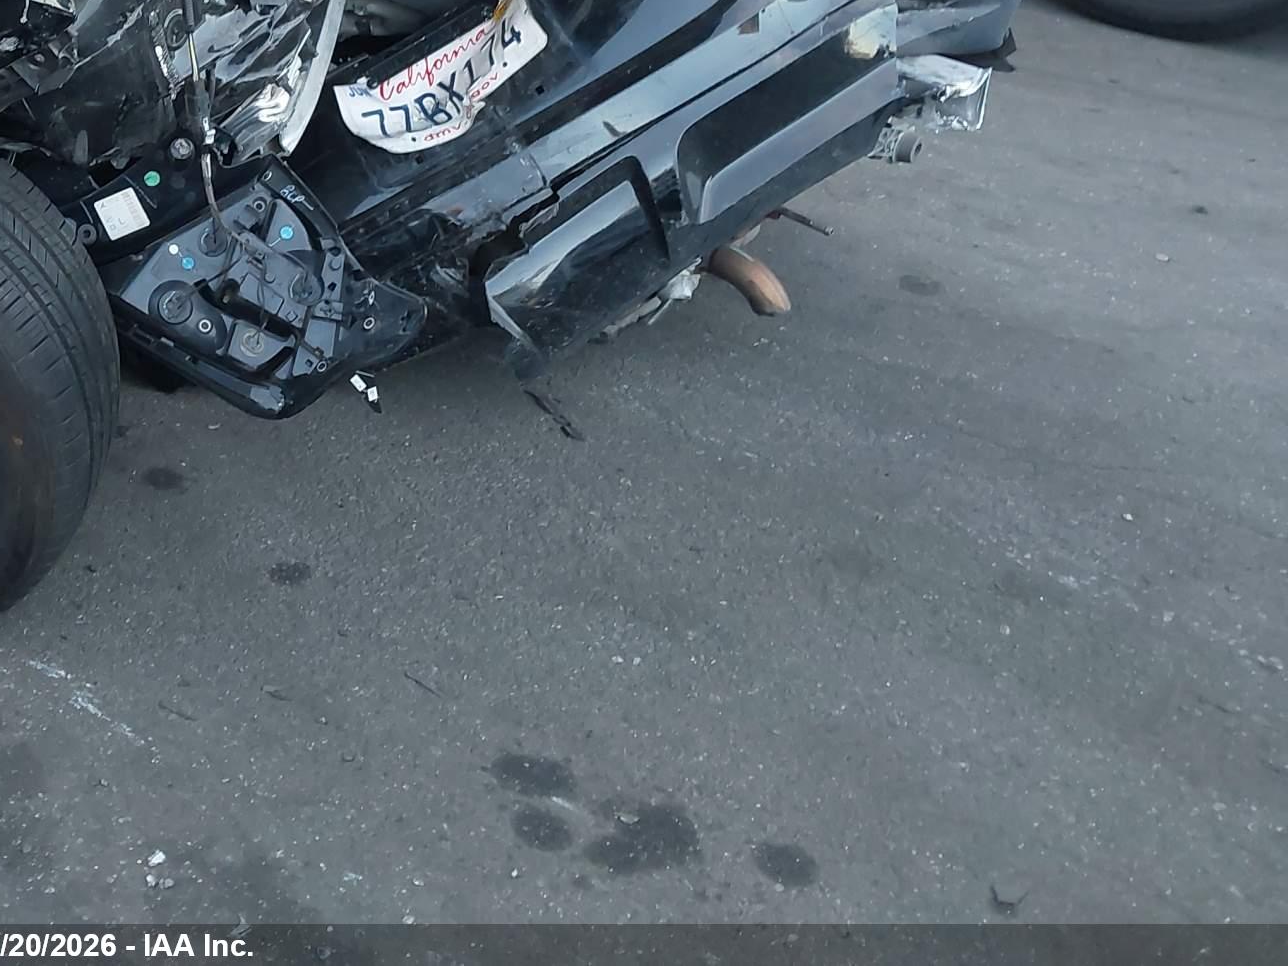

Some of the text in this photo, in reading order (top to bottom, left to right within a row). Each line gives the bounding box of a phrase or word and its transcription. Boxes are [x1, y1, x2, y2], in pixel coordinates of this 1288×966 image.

[348, 83, 373, 99] JUN
[362, 18, 522, 137] 77BX174
[379, 27, 486, 102] California
